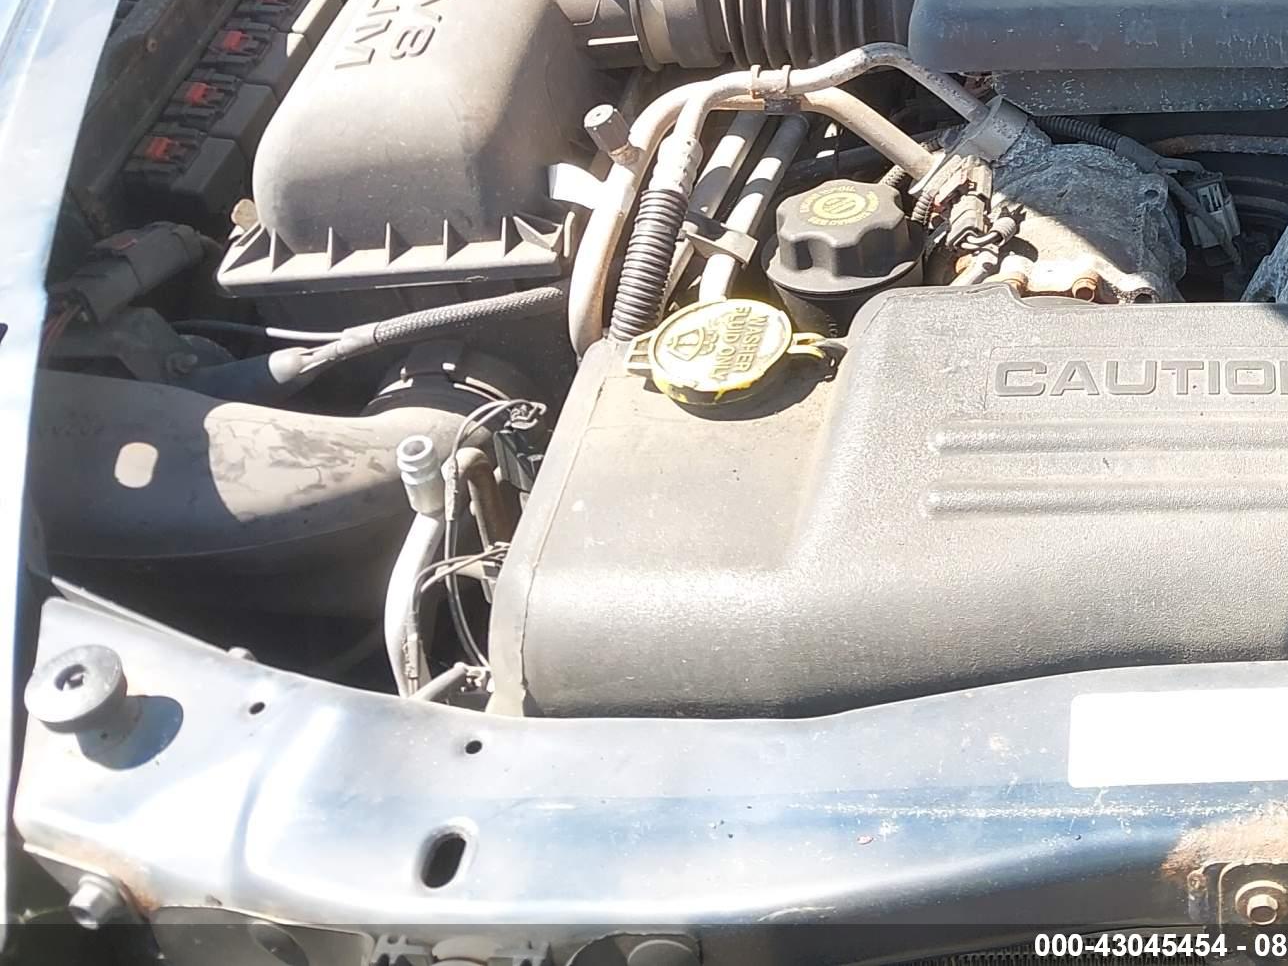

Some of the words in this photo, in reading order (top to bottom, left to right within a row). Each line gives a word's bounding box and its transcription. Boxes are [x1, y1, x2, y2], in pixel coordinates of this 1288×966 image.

[723, 306, 753, 344] FLUID
[734, 314, 769, 372] WASHER
[709, 346, 737, 382] ONLY
